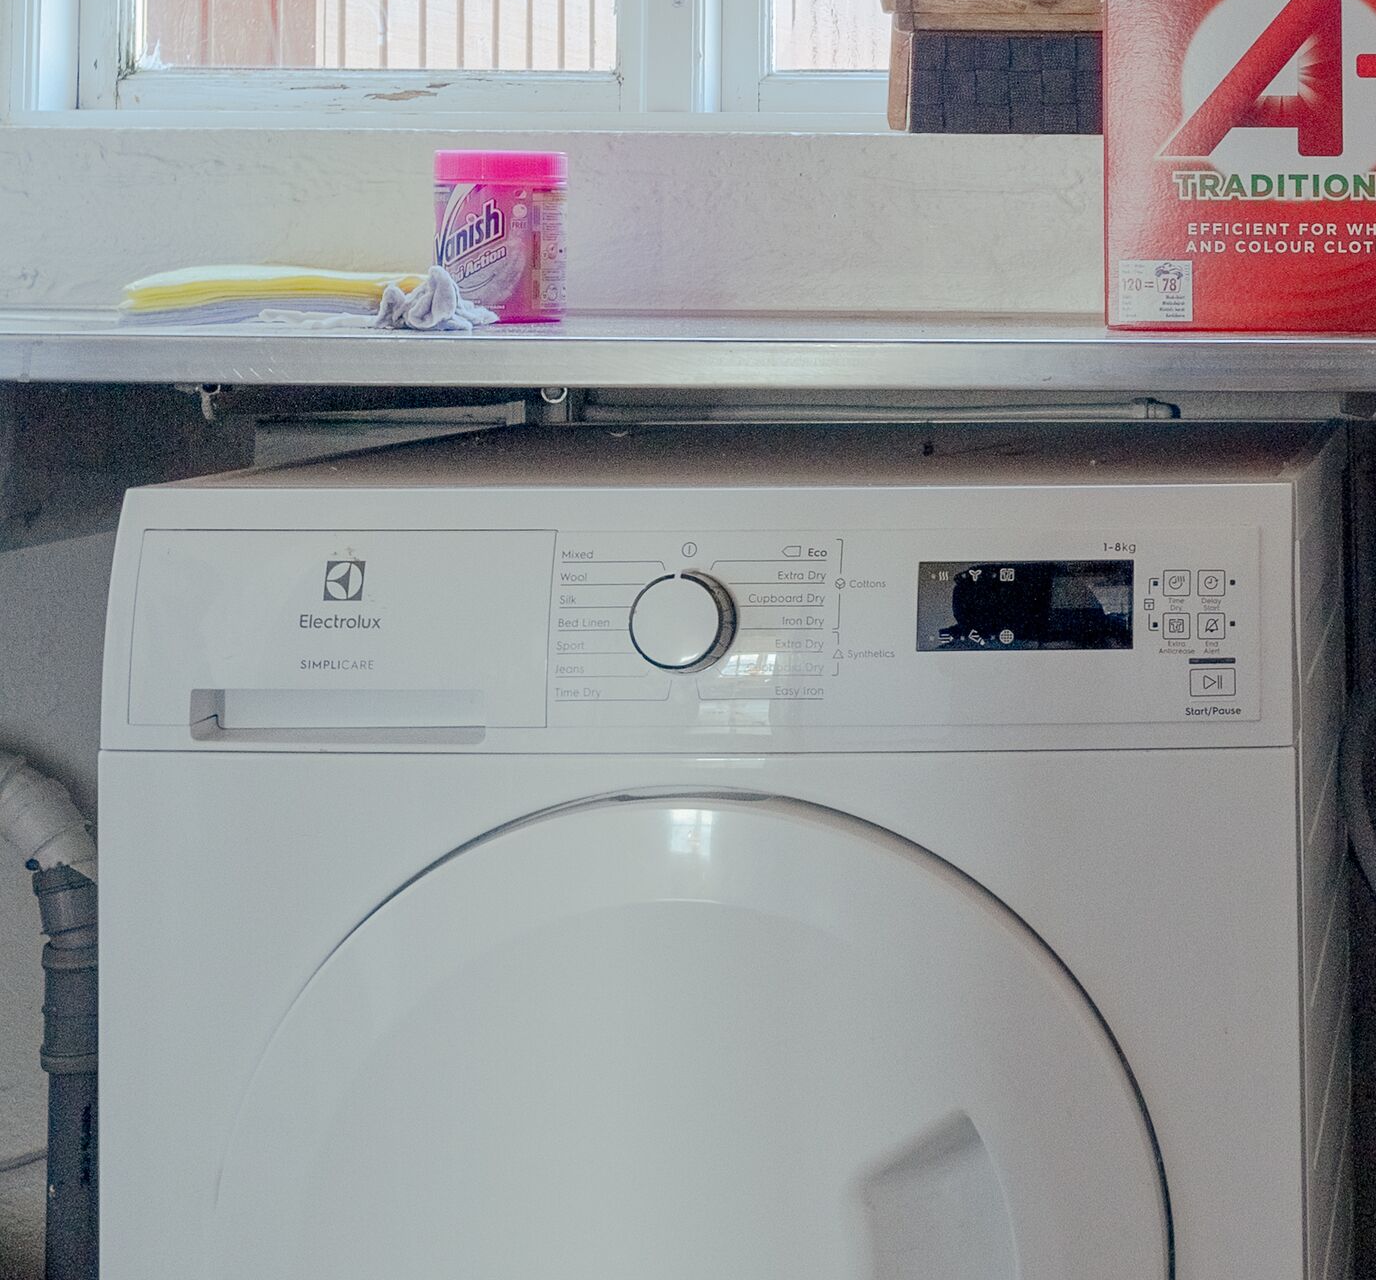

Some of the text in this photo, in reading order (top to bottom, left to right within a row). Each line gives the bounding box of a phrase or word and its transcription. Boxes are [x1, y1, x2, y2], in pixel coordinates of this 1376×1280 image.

[435, 198, 505, 267] Vanish
[1187, 222, 1289, 236] EFFICIENT
[1299, 222, 1338, 236] FOR
[1186, 241, 1230, 254] AND
[1235, 241, 1316, 254] COLOUR
[464, 246, 507, 279] Action
[1163, 278, 1177, 291] 78
[807, 547, 828, 557] Eco
[1102, 541, 1137, 554] 1-8kg
[561, 549, 594, 560] Mixed
[560, 572, 588, 583] Wool
[777, 571, 827, 582] Extra Dry
[848, 579, 887, 589] Cottons
[559, 594, 577, 605] Silk
[748, 593, 826, 605] Cupboard Dry
[1200, 597, 1222, 605] Delay
[299, 614, 382, 630] Electrolux
[558, 617, 610, 628] Bed Linen
[782, 616, 825, 628] Iron Dry
[556, 640, 585, 652] Sport
[775, 639, 825, 650] Extra Dry
[847, 649, 896, 660] Synthetics
[300, 660, 375, 670] SIMPLICARE
[554, 663, 585, 674] Jeans
[805, 662, 825, 673] Dry
[554, 687, 601, 699] Time Dry
[775, 686, 825, 697] Easy Iron
[1185, 706, 1242, 717] Start/Pause
